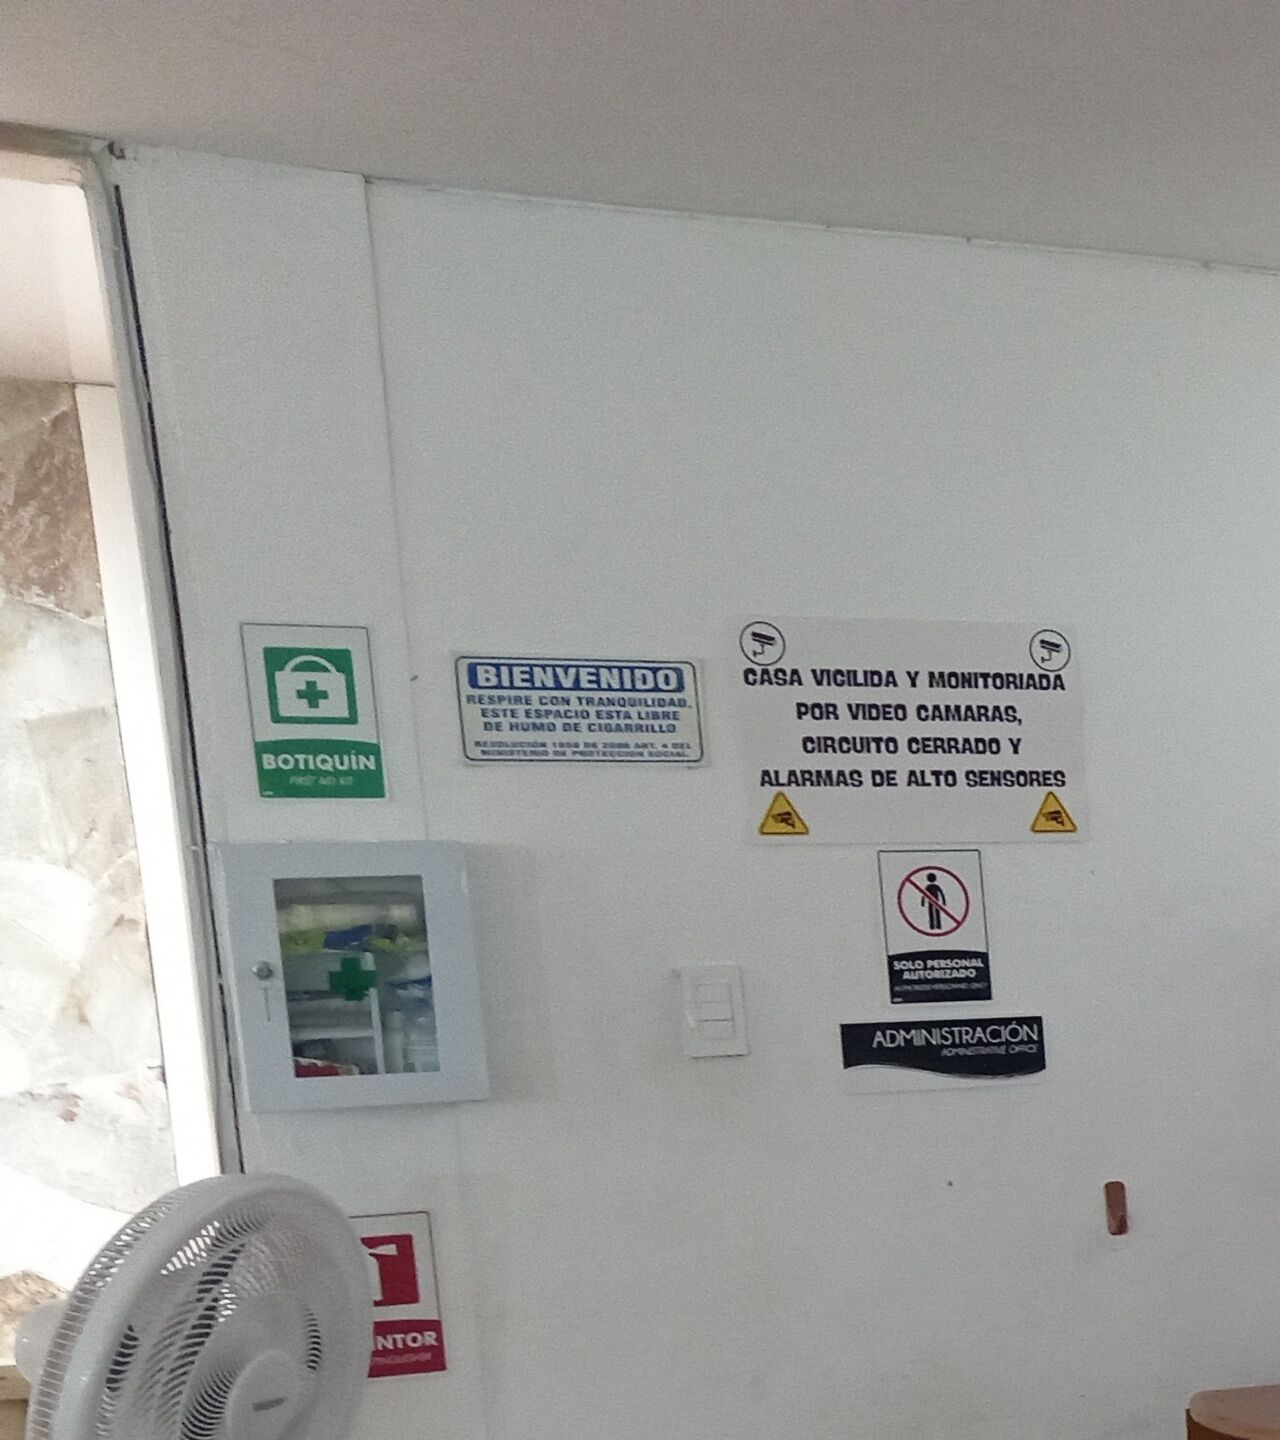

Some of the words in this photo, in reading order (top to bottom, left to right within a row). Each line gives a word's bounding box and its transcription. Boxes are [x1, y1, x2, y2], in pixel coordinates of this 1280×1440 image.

[476, 665, 679, 690] BIENVENIDO
[743, 667, 804, 686] CASA
[810, 668, 899, 688] VIGILIDA
[906, 670, 920, 688] Y
[928, 671, 1066, 691] MONITORIADA
[466, 694, 535, 706] RESPIRE
[539, 695, 571, 706] CON
[480, 708, 519, 719] ESTE
[524, 709, 590, 720] ESPACIO
[596, 710, 632, 720] ESTA
[637, 711, 680, 721] LIBRE
[796, 702, 840, 721] POR
[846, 703, 908, 721] VIDEO
[916, 704, 1023, 726] CAMARAS,
[483, 722, 503, 732] DE
[509, 722, 557, 732] HUMO
[562, 722, 582, 732] DE
[588, 722, 677, 734] CIGARRILLO
[802, 736, 899, 754] CIRCUITO
[907, 736, 1001, 754] CERRADO
[1008, 738, 1022, 755] Y
[262, 749, 377, 772] BOTIQUÍN
[760, 769, 864, 788] ALARMAS
[870, 769, 898, 788] DE
[906, 769, 958, 788] ALTO
[965, 769, 1066, 788] SENSORES
[893, 960, 924, 971] SOLO
[926, 957, 985, 969] PERSONAL
[902, 968, 977, 980] AUTORIZADO
[872, 1020, 1039, 1049] ADMINISTRACIÓN
[375, 1330, 439, 1351] NTOR
